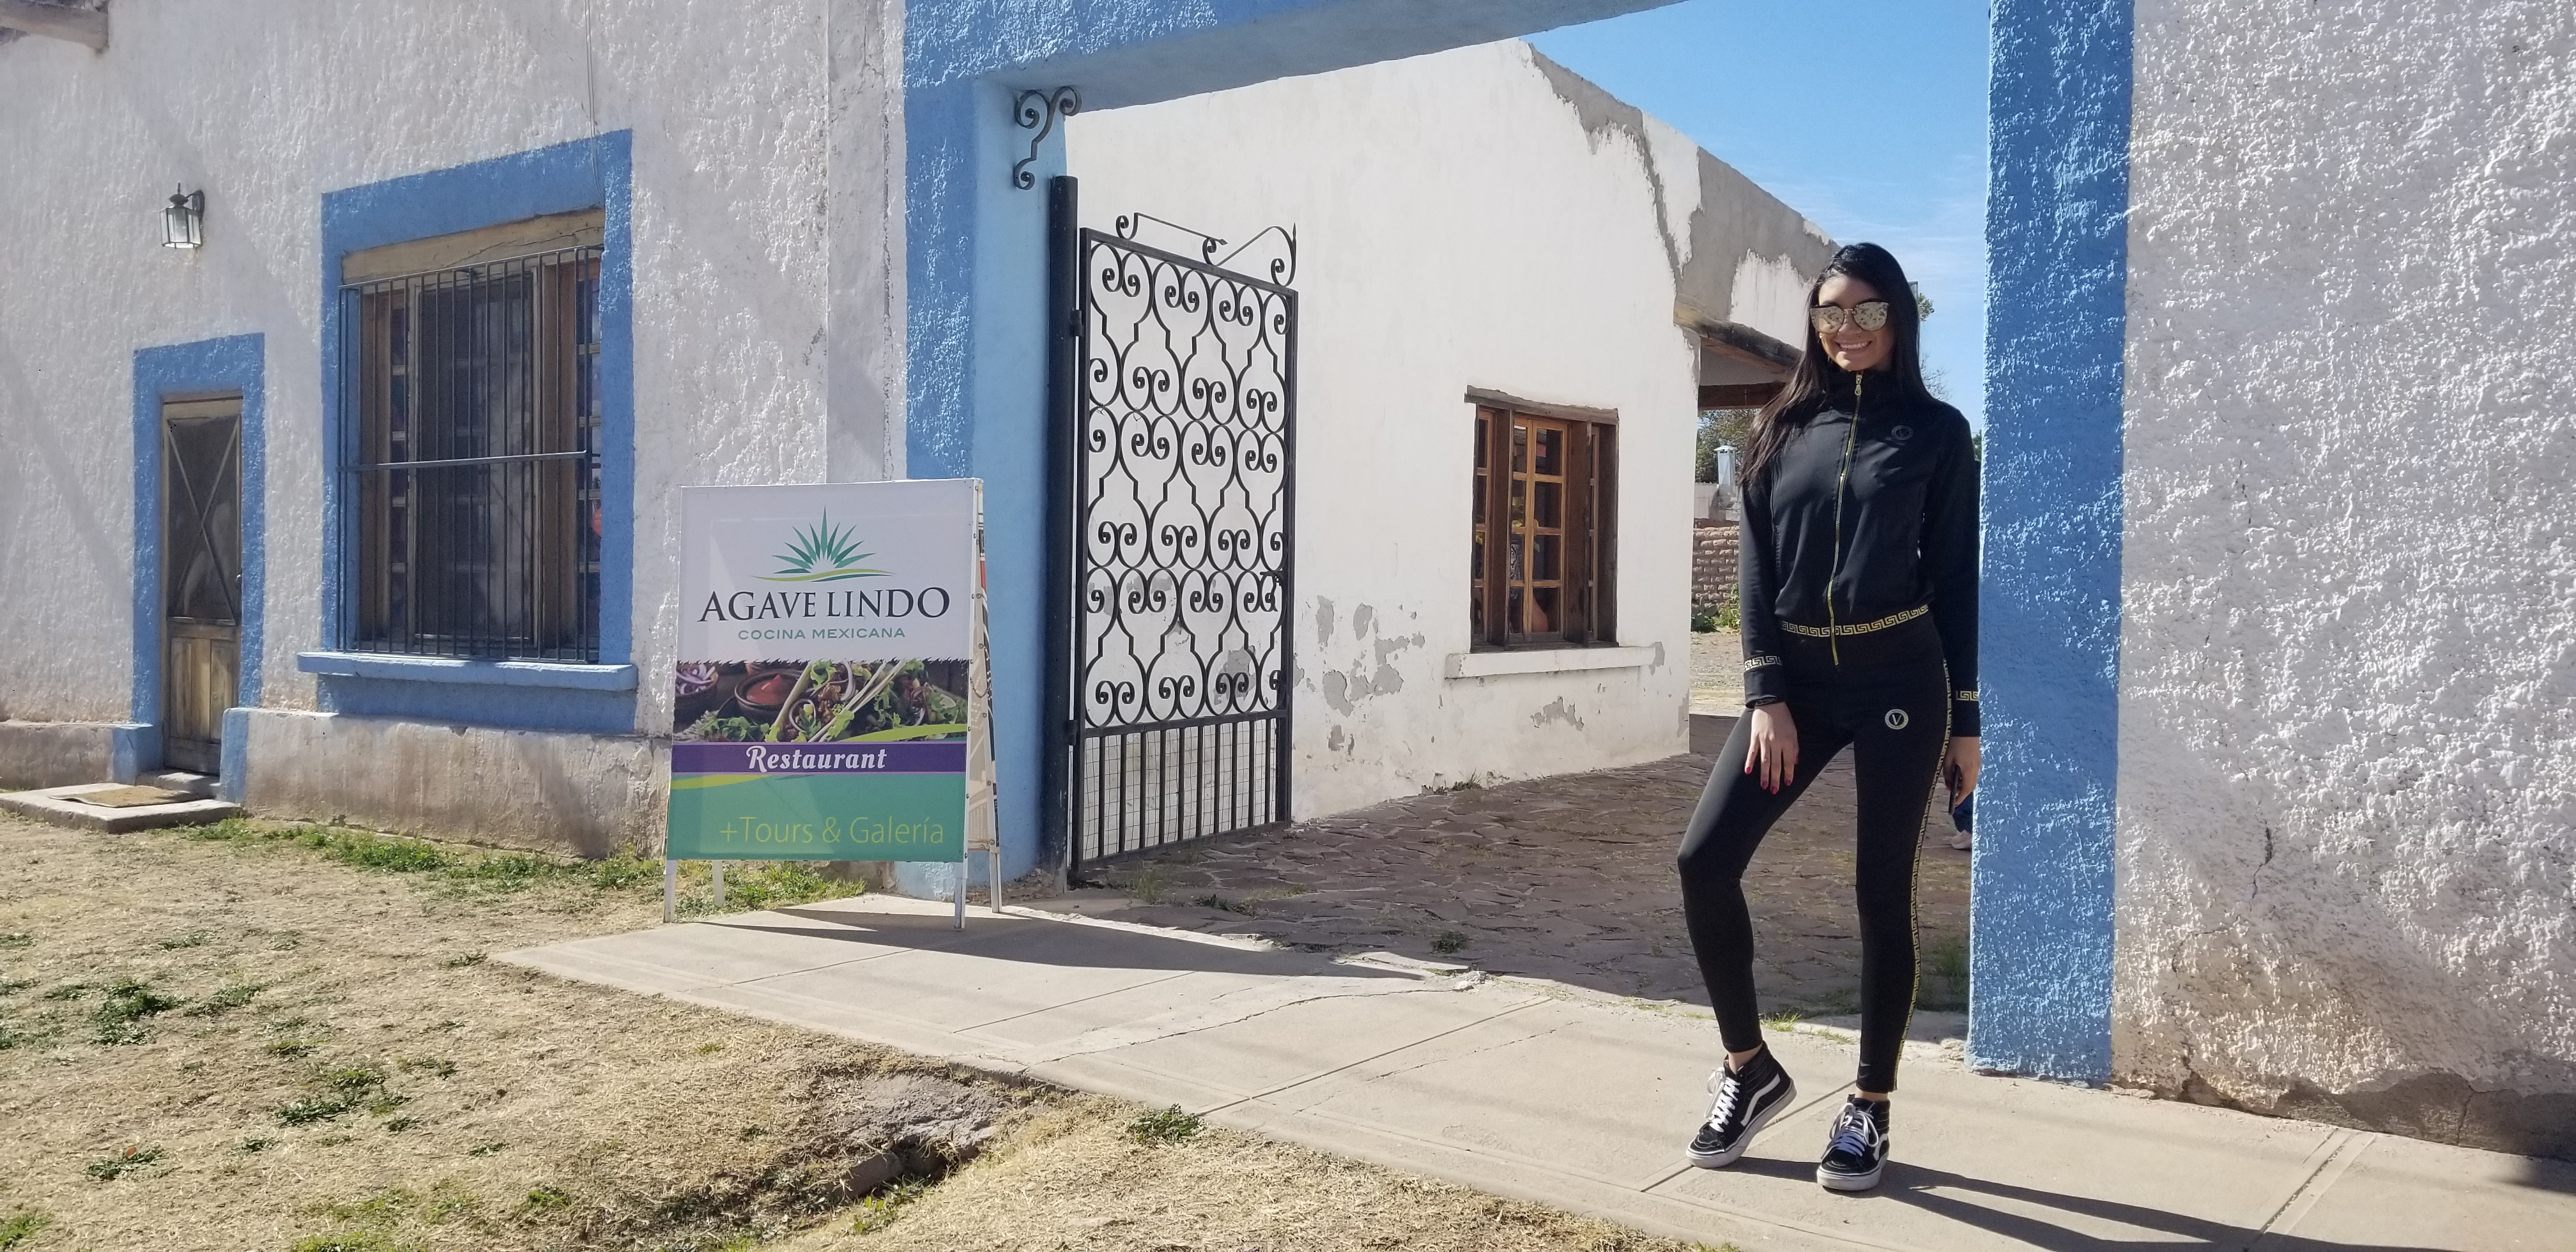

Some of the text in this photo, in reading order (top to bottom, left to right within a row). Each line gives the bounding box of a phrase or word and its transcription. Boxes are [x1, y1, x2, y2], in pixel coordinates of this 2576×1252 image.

[697, 587, 950, 622] AGAVE LINDO
[738, 627, 906, 640] COCINA MEXICANA
[1892, 714, 1902, 726] V
[746, 745, 887, 773] Restaurant
[822, 816, 841, 843] &
[850, 816, 944, 844] Galería
